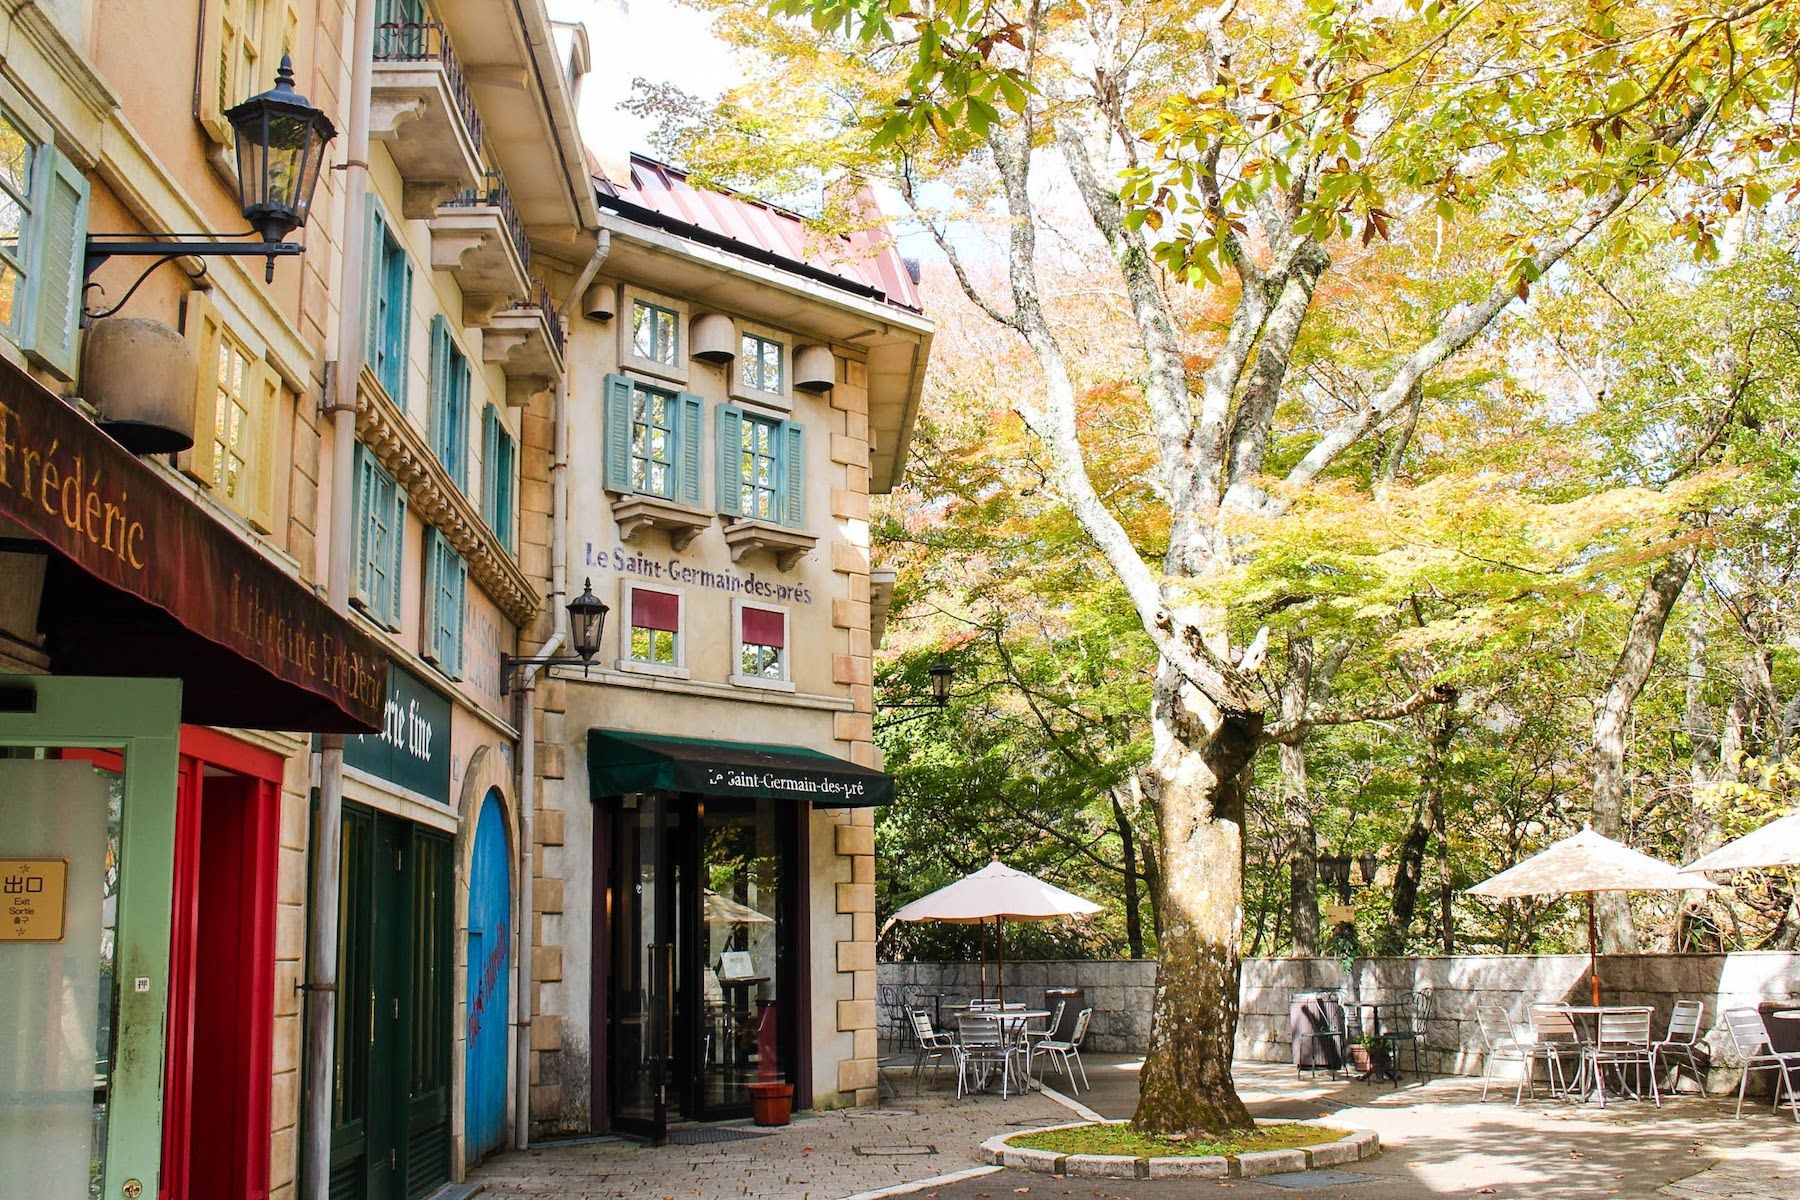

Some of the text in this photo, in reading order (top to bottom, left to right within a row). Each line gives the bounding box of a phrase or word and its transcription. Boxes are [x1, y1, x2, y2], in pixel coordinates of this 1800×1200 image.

[0, 400, 144, 570] Frédéric
[585, 541, 812, 605] Le Saint-Germain-des-prés
[409, 698, 432, 762] fine
[4, 875, 43, 894] 出口
[14, 898, 30, 906] Exit
[9, 907, 35, 915] Sortie
